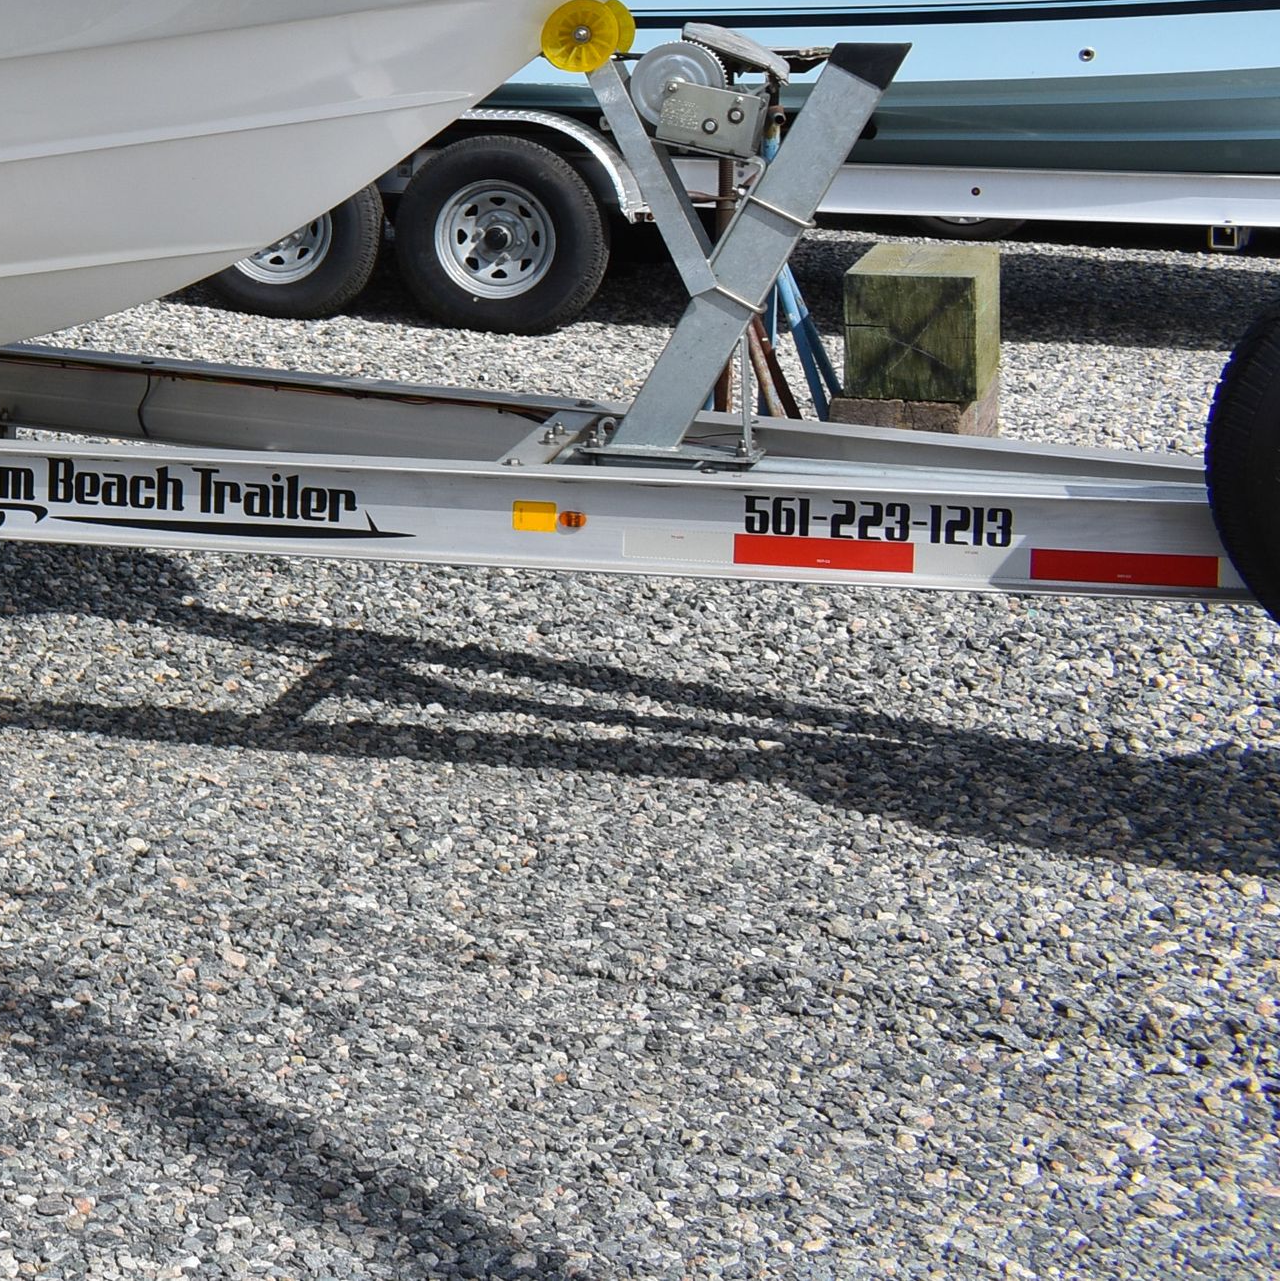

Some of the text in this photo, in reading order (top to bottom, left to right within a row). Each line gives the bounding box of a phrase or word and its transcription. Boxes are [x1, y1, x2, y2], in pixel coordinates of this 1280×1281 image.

[47, 458, 184, 511] Beach
[192, 467, 358, 522] Trailer
[744, 495, 1013, 547] 561-223-1213
